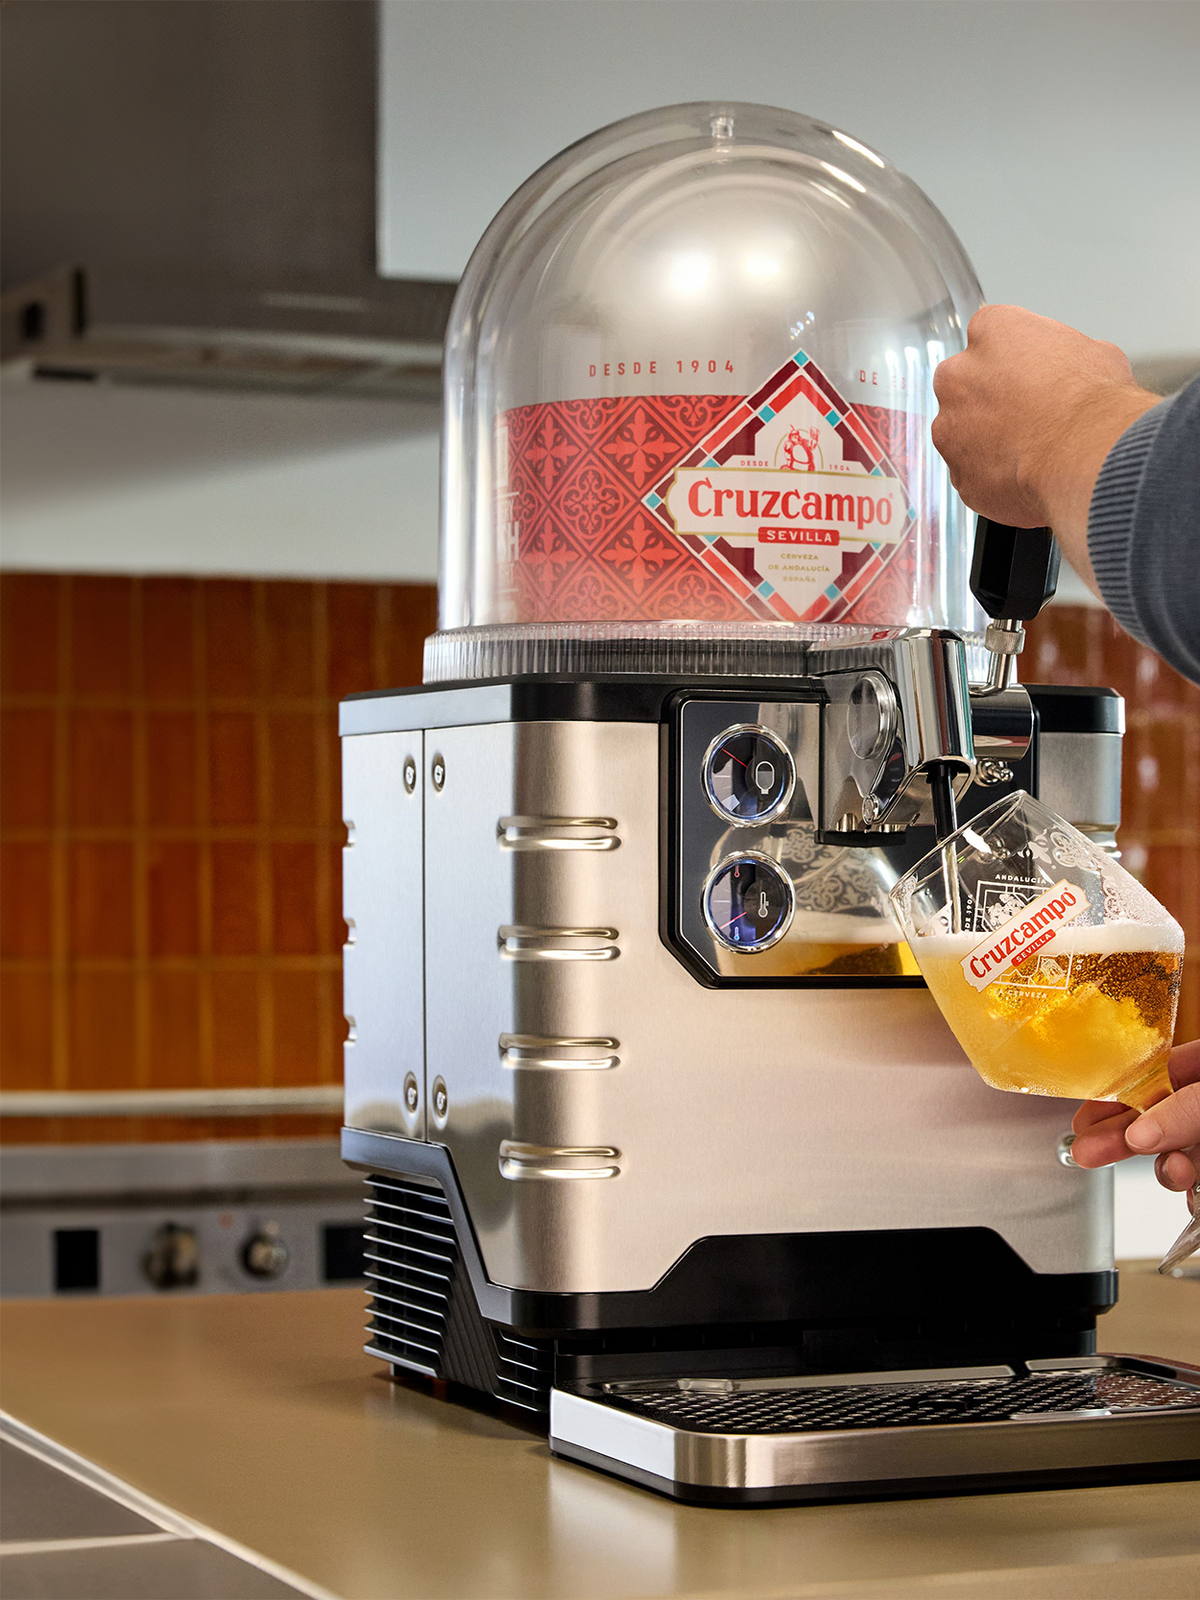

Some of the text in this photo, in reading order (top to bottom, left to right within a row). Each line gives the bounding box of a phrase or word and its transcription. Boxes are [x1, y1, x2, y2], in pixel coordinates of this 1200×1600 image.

[589, 360, 734, 377] DESDE 1904
[688, 477, 892, 530] Cruzcampo
[767, 530, 832, 542] SEVILLA
[782, 564, 830, 572] ANDALUCÍA
[783, 575, 816, 583] ESPAÑA
[995, 874, 1047, 884] ANDALUCÍA
[969, 892, 1077, 979] Cruzcampo
[1016, 933, 1052, 962] SEVILLA
